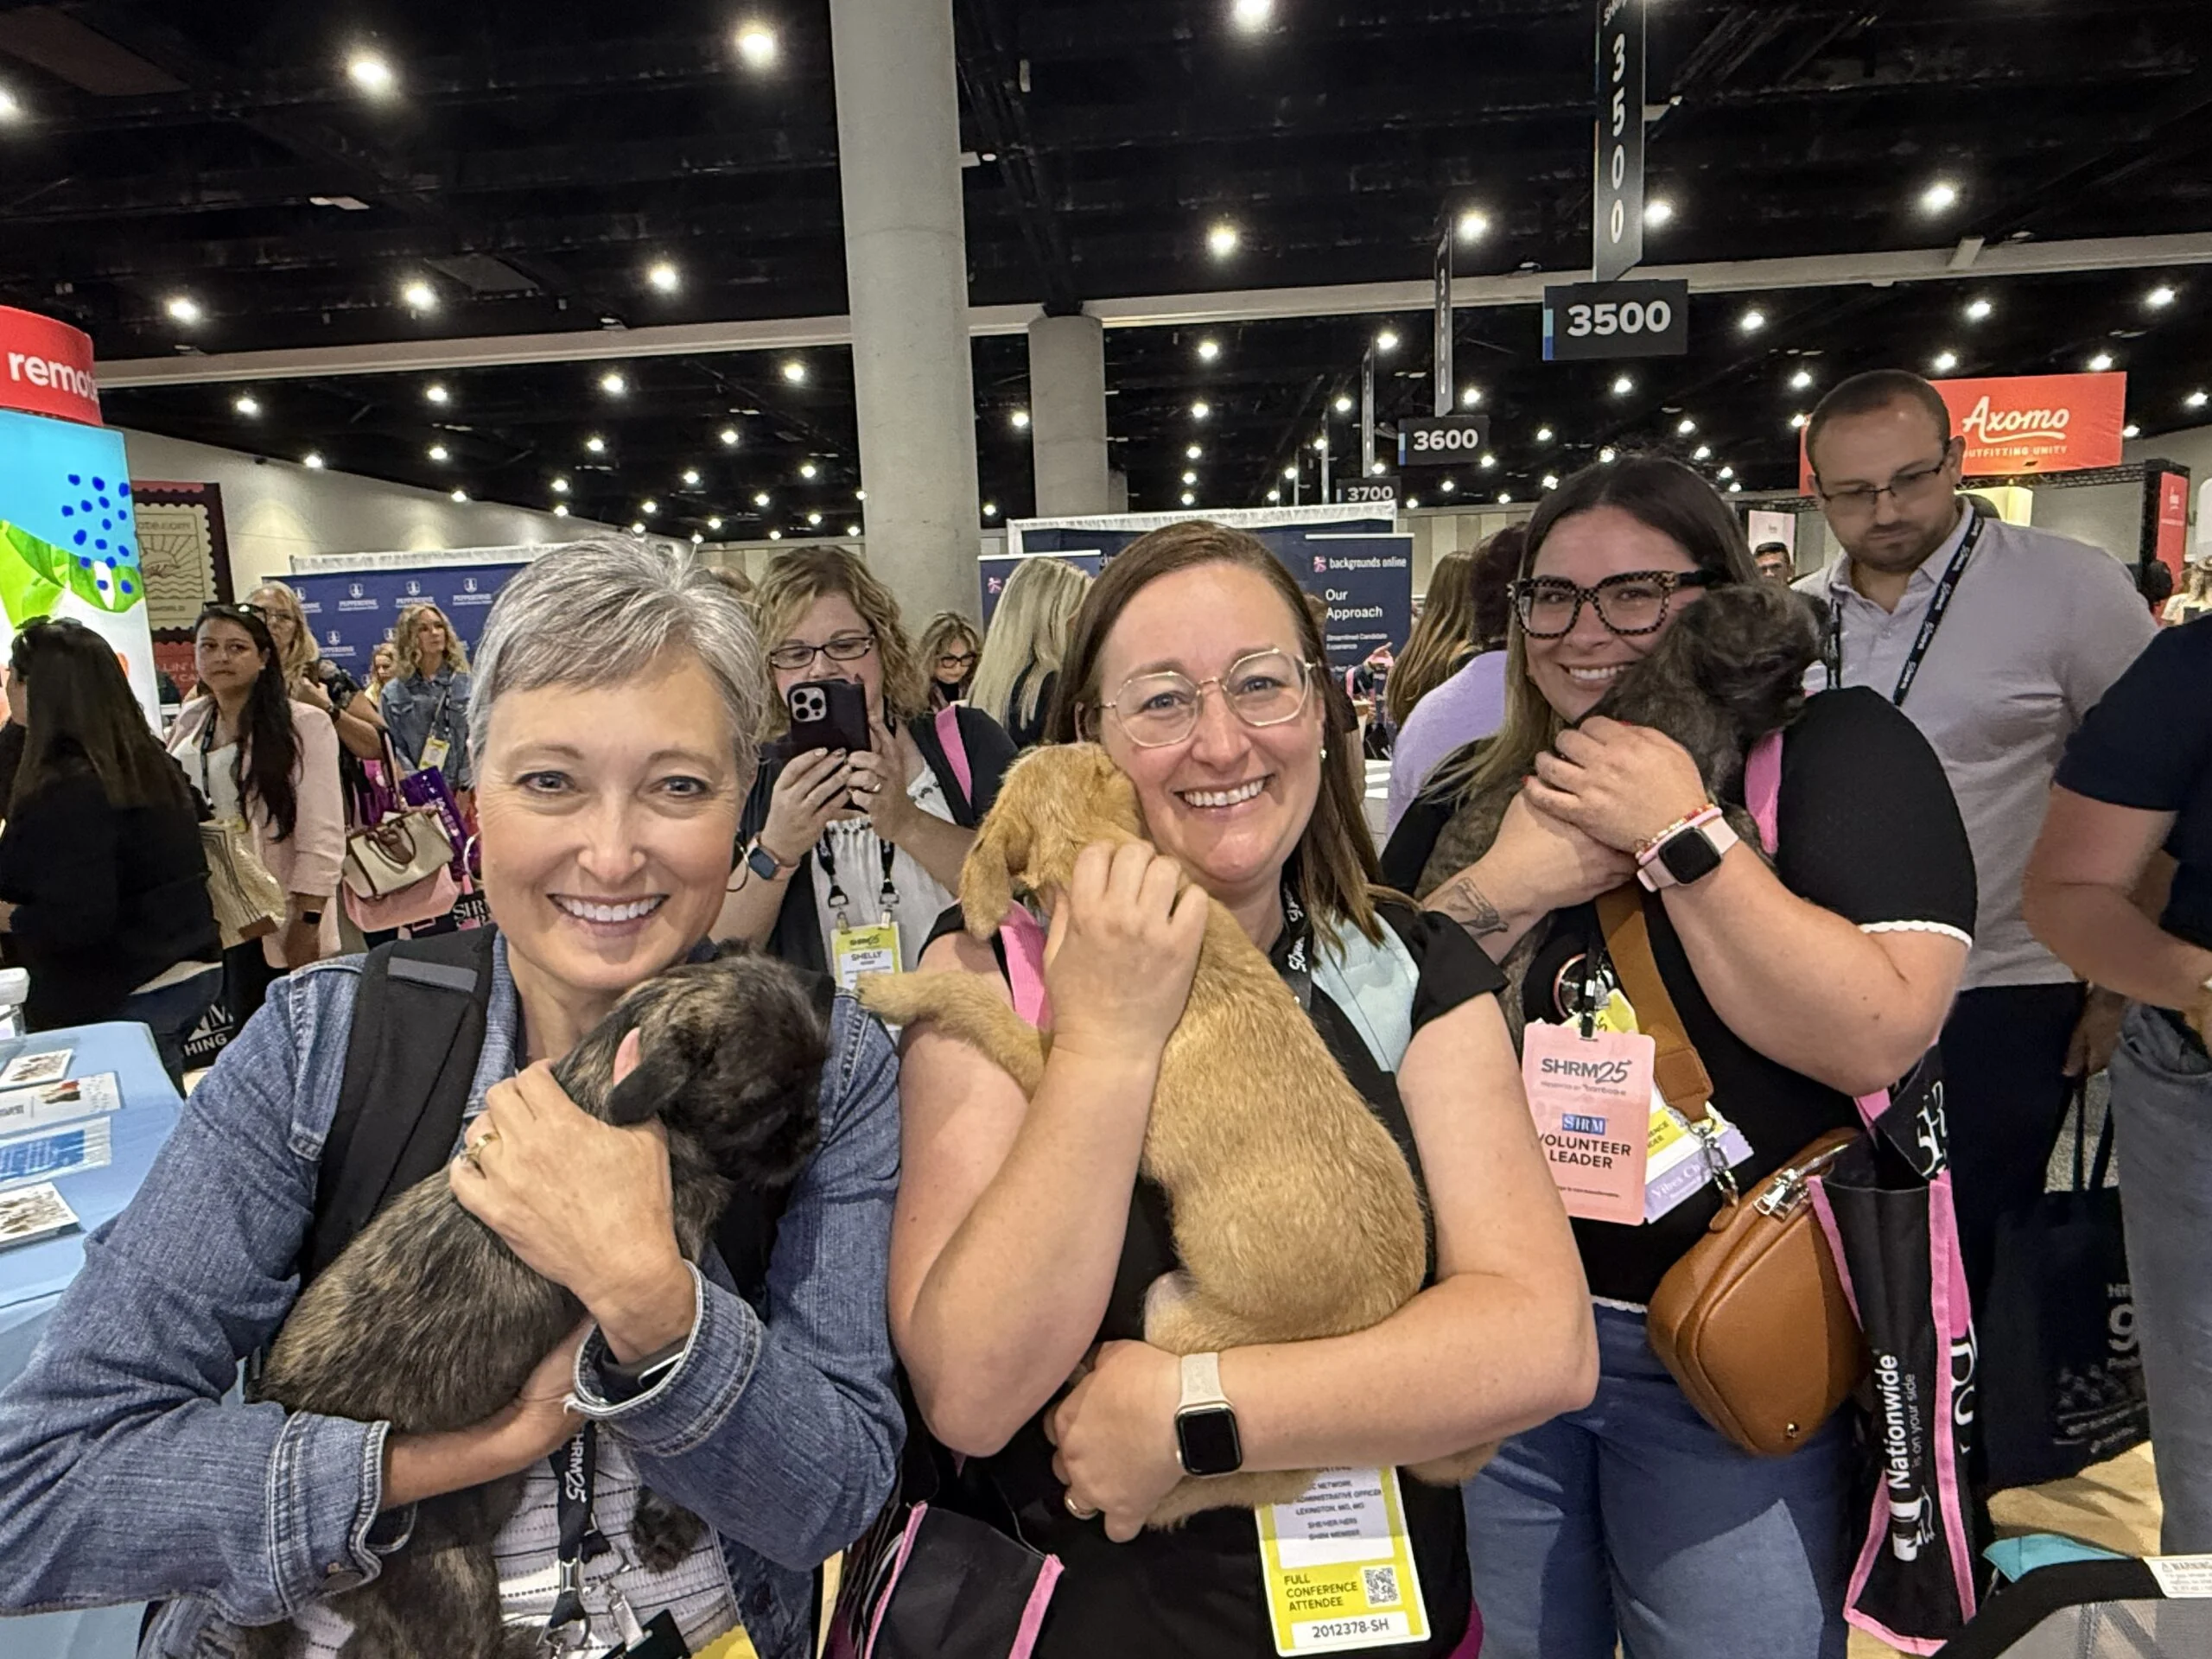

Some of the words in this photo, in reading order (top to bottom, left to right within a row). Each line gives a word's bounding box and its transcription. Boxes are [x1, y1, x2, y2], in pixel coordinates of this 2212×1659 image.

[1567, 300, 1671, 337] 3500
[1961, 395, 2069, 443] Axomo
[1413, 429, 1478, 450] 3600
[2033, 445, 2067, 455] UNITY
[1348, 486, 1394, 501] 3700
[1329, 557, 1381, 570] backgrounds
[1382, 556, 1407, 568] online
[1325, 588, 1348, 601] Our
[1326, 606, 1383, 620] Approach
[453, 899, 485, 920] SHR
[851, 951, 883, 961] SHELLY
[184, 1033, 227, 1056] HING
[1541, 1058, 1632, 1084] SHRM25
[1549, 1149, 1613, 1169] LEADER
[1902, 1374, 1917, 1402] side
[1874, 1354, 1910, 1490] Nationwide
[1909, 1405, 1923, 1434] your
[1911, 1436, 1923, 1454] on
[564, 1433, 588, 1503] HRM25
[1284, 1574, 1311, 1586] FULL
[1286, 1581, 1358, 1598] CONFERENCE
[1289, 1597, 1344, 1611] ATTENDEE
[1312, 1618, 1389, 1638] 2012378-SH
